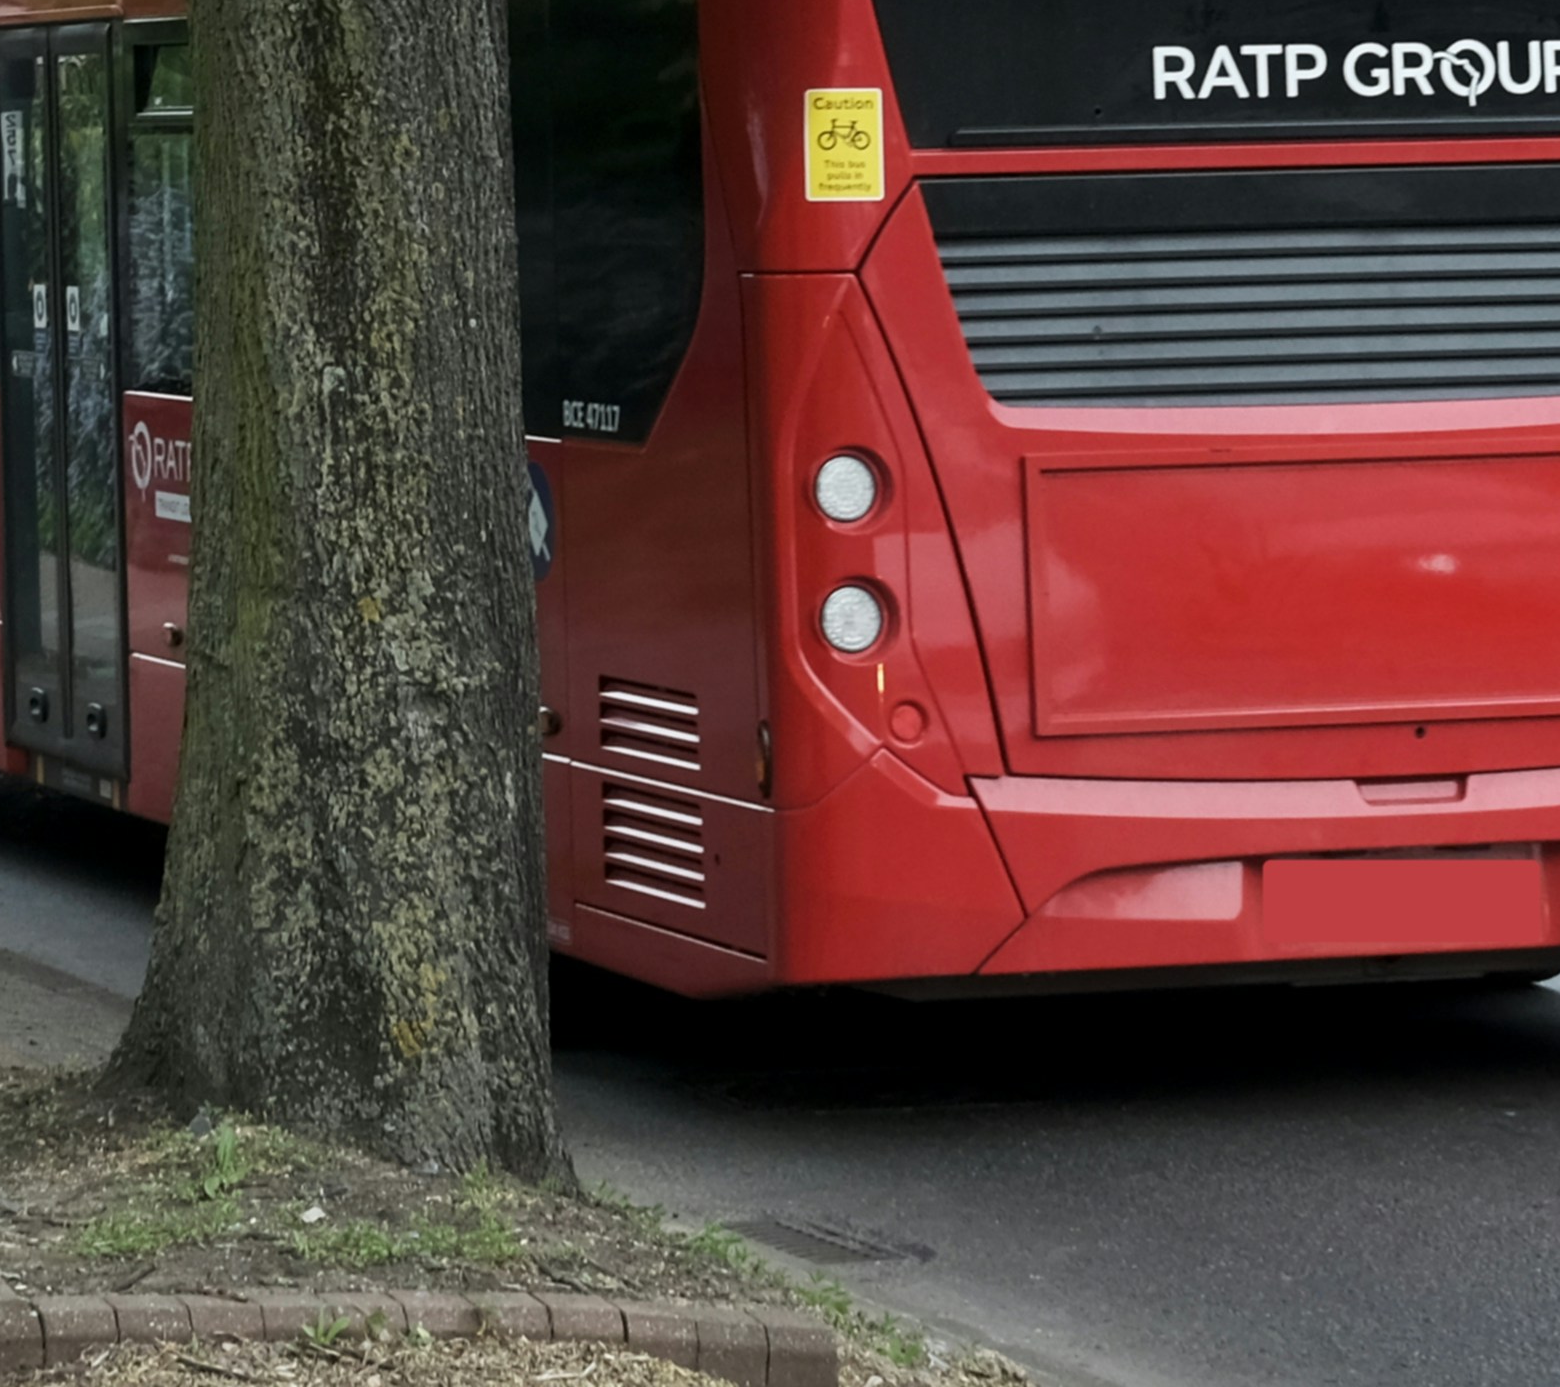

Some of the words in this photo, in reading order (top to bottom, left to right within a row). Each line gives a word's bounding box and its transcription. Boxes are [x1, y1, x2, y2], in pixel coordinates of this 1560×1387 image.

[1152, 44, 1328, 100] RATP
[813, 97, 874, 110] Caution
[824, 159, 845, 169] This
[847, 159, 866, 169] bus
[826, 171, 852, 181] pulls
[854, 171, 864, 180] in
[818, 182, 872, 192] frequently
[562, 399, 585, 429] BCE
[586, 402, 621, 433] 47117
